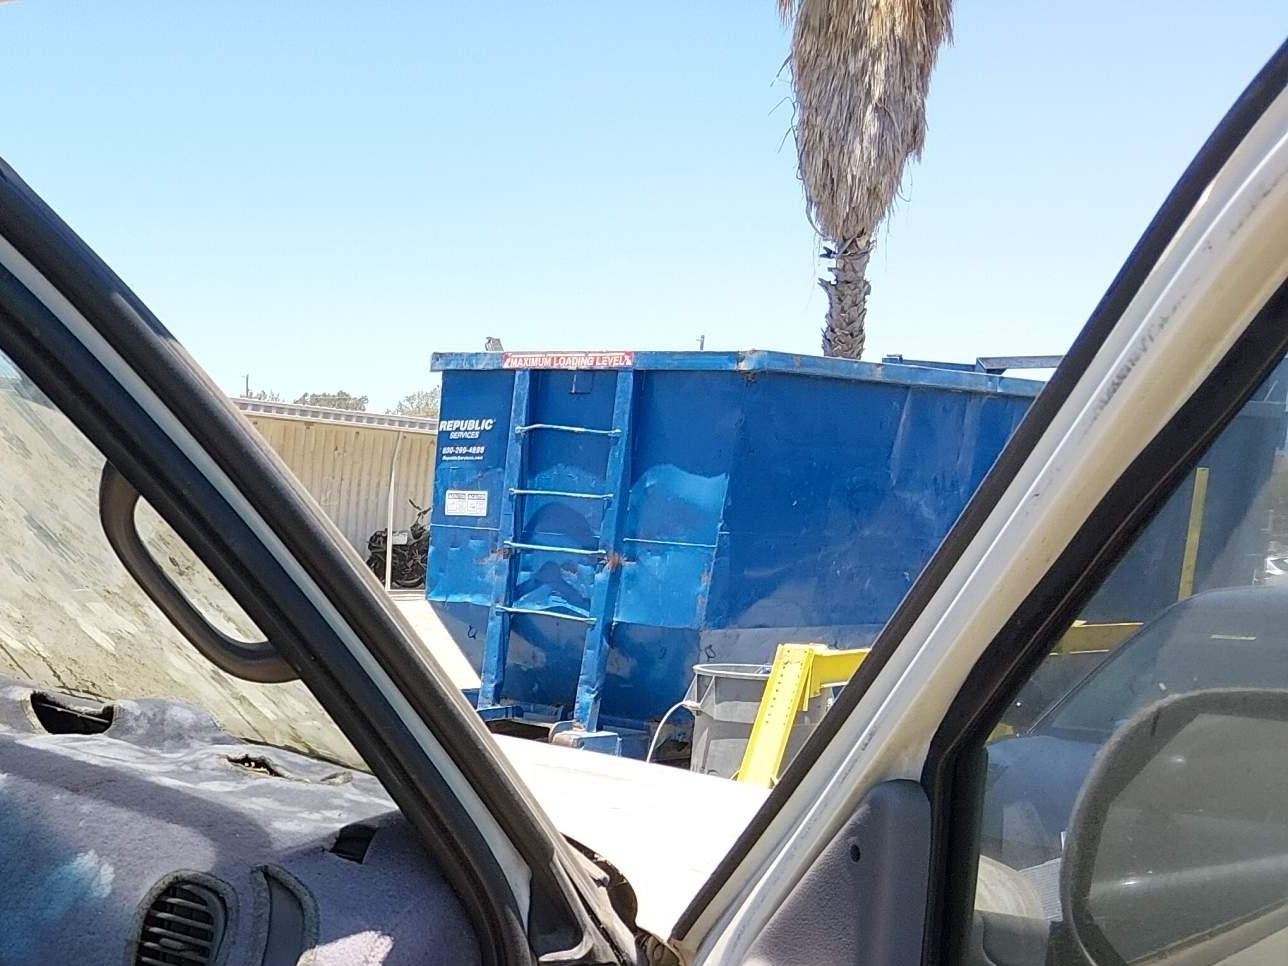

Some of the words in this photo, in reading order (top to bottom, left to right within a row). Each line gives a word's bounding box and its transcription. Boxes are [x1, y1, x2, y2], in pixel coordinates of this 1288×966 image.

[510, 357, 551, 367] MAXIMUM
[553, 356, 593, 366] LOADING
[596, 355, 625, 366] LEVEL
[439, 419, 493, 431] REPUBLIC
[449, 431, 480, 439] SERVICES
